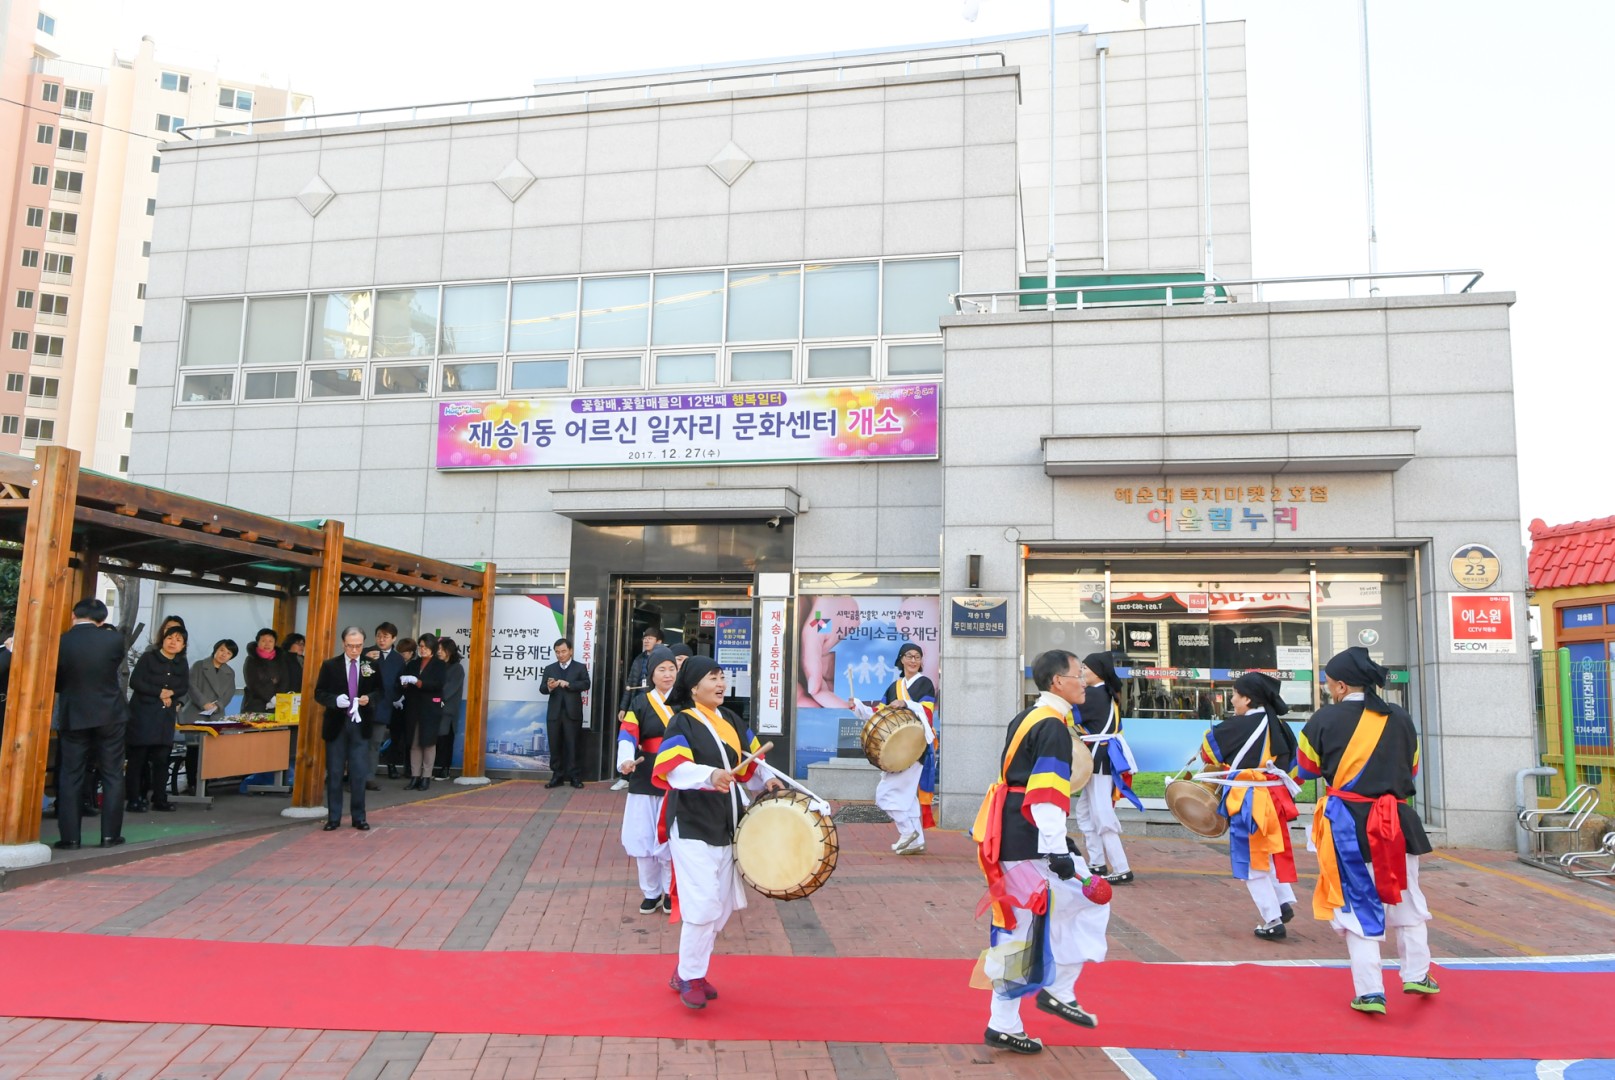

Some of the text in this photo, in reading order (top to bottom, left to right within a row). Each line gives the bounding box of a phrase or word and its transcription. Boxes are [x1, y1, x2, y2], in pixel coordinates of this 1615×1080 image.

[688, 394, 727, 407] 12번째
[732, 392, 782, 406] 행복일터
[468, 408, 902, 448] 재송1동 어르신 일자리 문화센터 개소
[628, 448, 721, 460] 2017. 12. 27(수)
[1147, 507, 1298, 532] 어울림누리
[1465, 564, 1486, 576] 23
[836, 610, 924, 621] 서민금융진흥원 사업수행기관
[967, 612, 991, 620] 재송1동
[1461, 609, 1502, 624] 에스원
[498, 628, 540, 638] 사업수행기관
[954, 622, 1004, 632] 주민복지문화센터
[836, 626, 938, 641] 신한미소금융재단
[1453, 642, 1487, 650] SECOM
[769, 610, 781, 711] 재송1동주민센터
